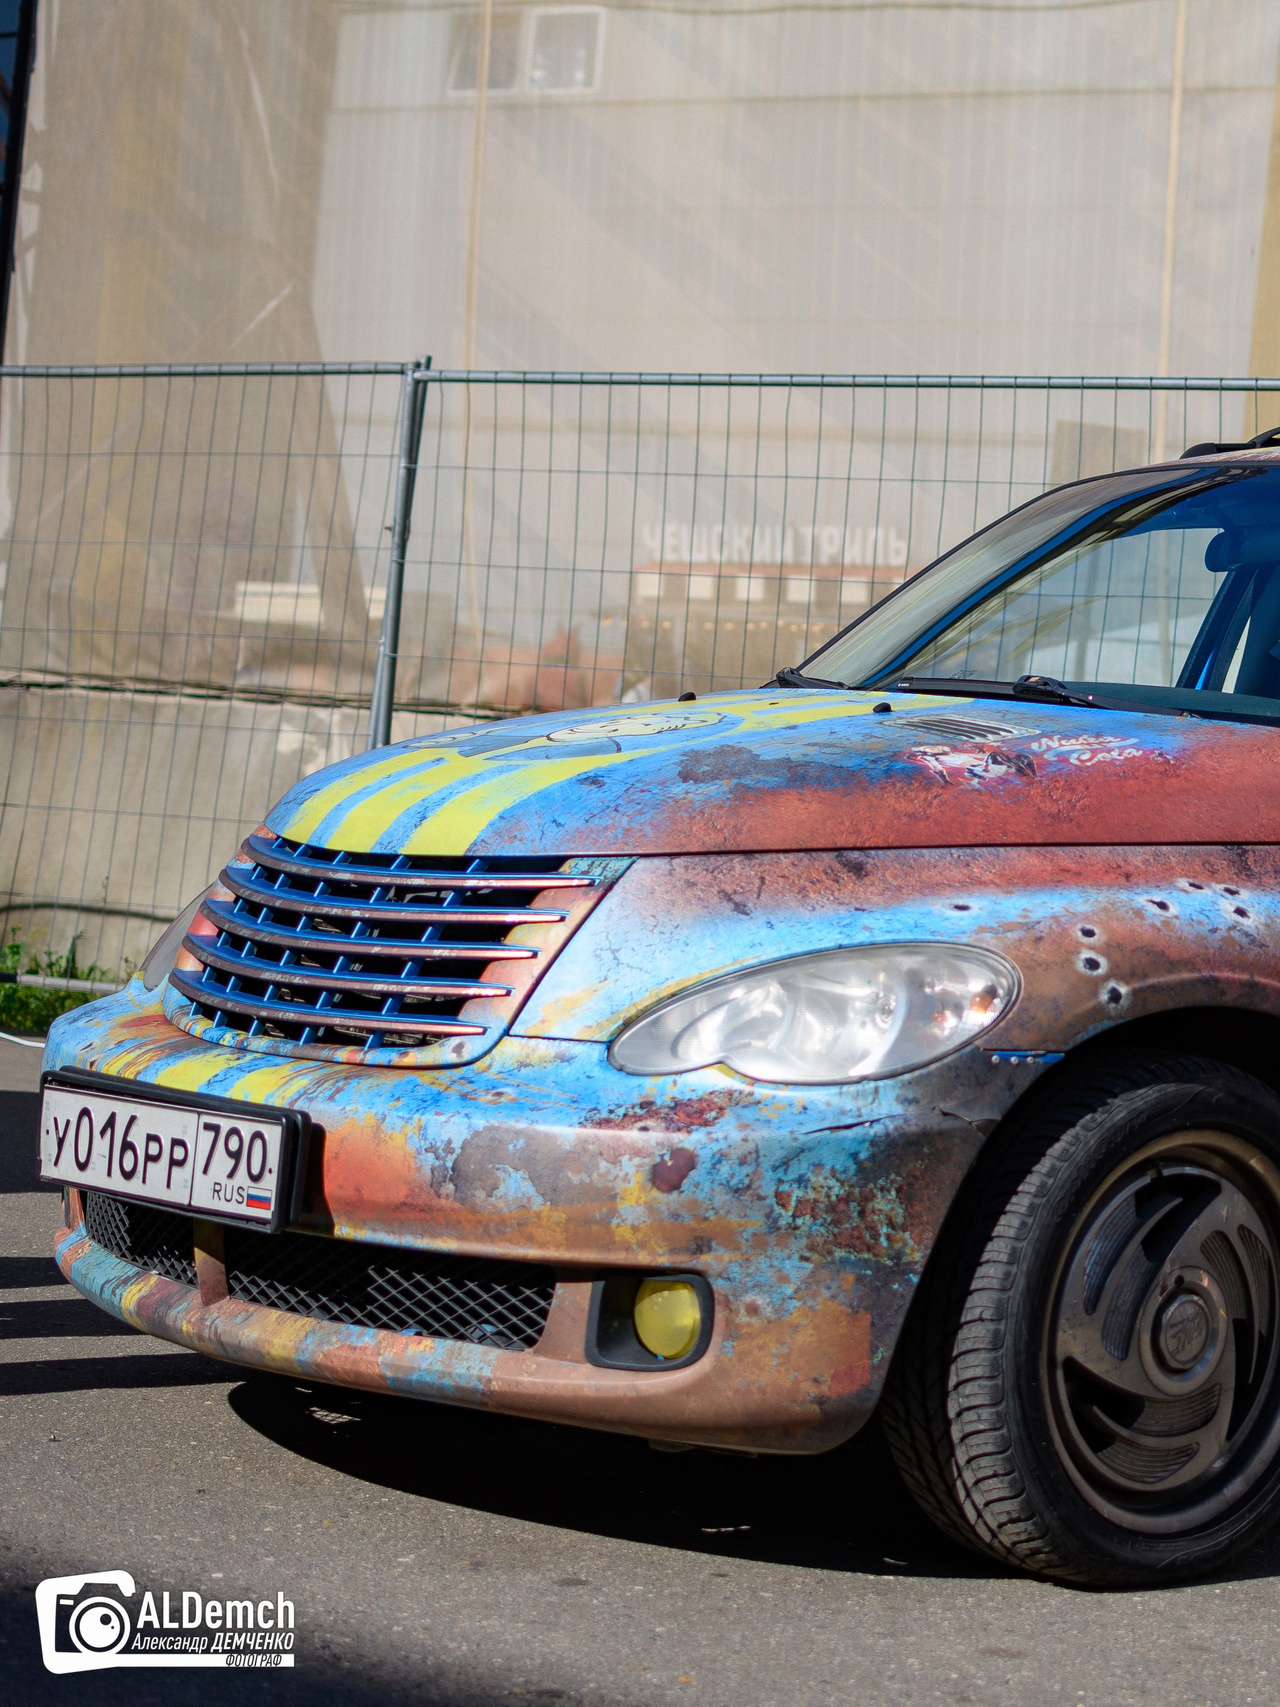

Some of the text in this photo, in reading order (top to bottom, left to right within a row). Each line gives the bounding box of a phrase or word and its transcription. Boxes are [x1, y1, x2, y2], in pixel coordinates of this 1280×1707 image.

[1068, 747, 1143, 767] Cola
[53, 1105, 269, 1190] У016РР 790
[211, 1180, 246, 1206] RUS
